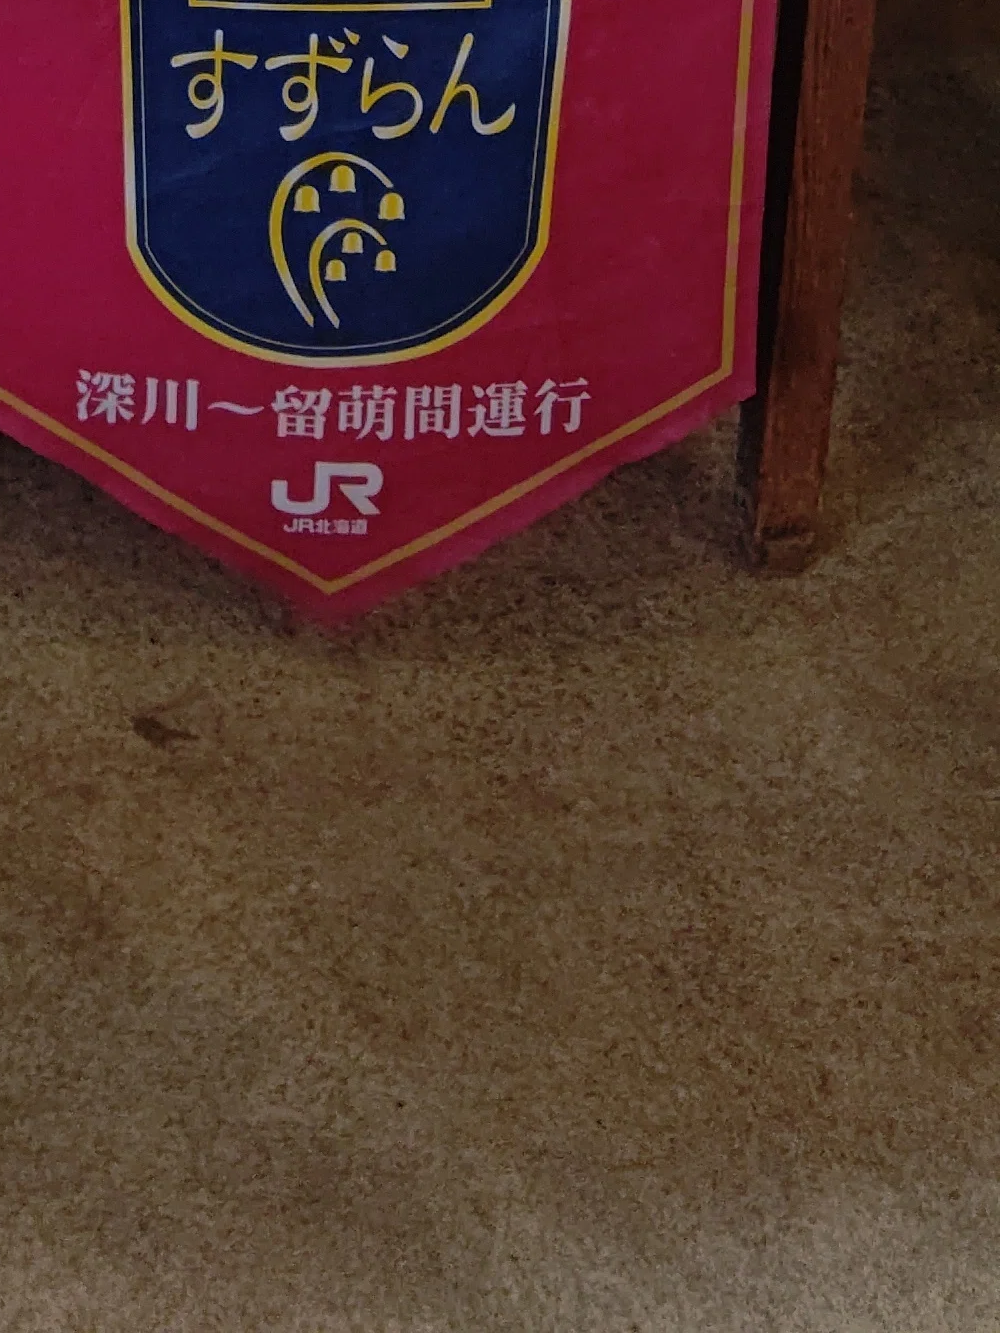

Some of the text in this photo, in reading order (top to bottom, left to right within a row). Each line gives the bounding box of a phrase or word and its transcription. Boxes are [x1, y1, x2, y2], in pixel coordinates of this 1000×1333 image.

[170, 27, 517, 139] すずらん
[271, 461, 384, 516] JR
[283, 518, 368, 535] JR北海道
